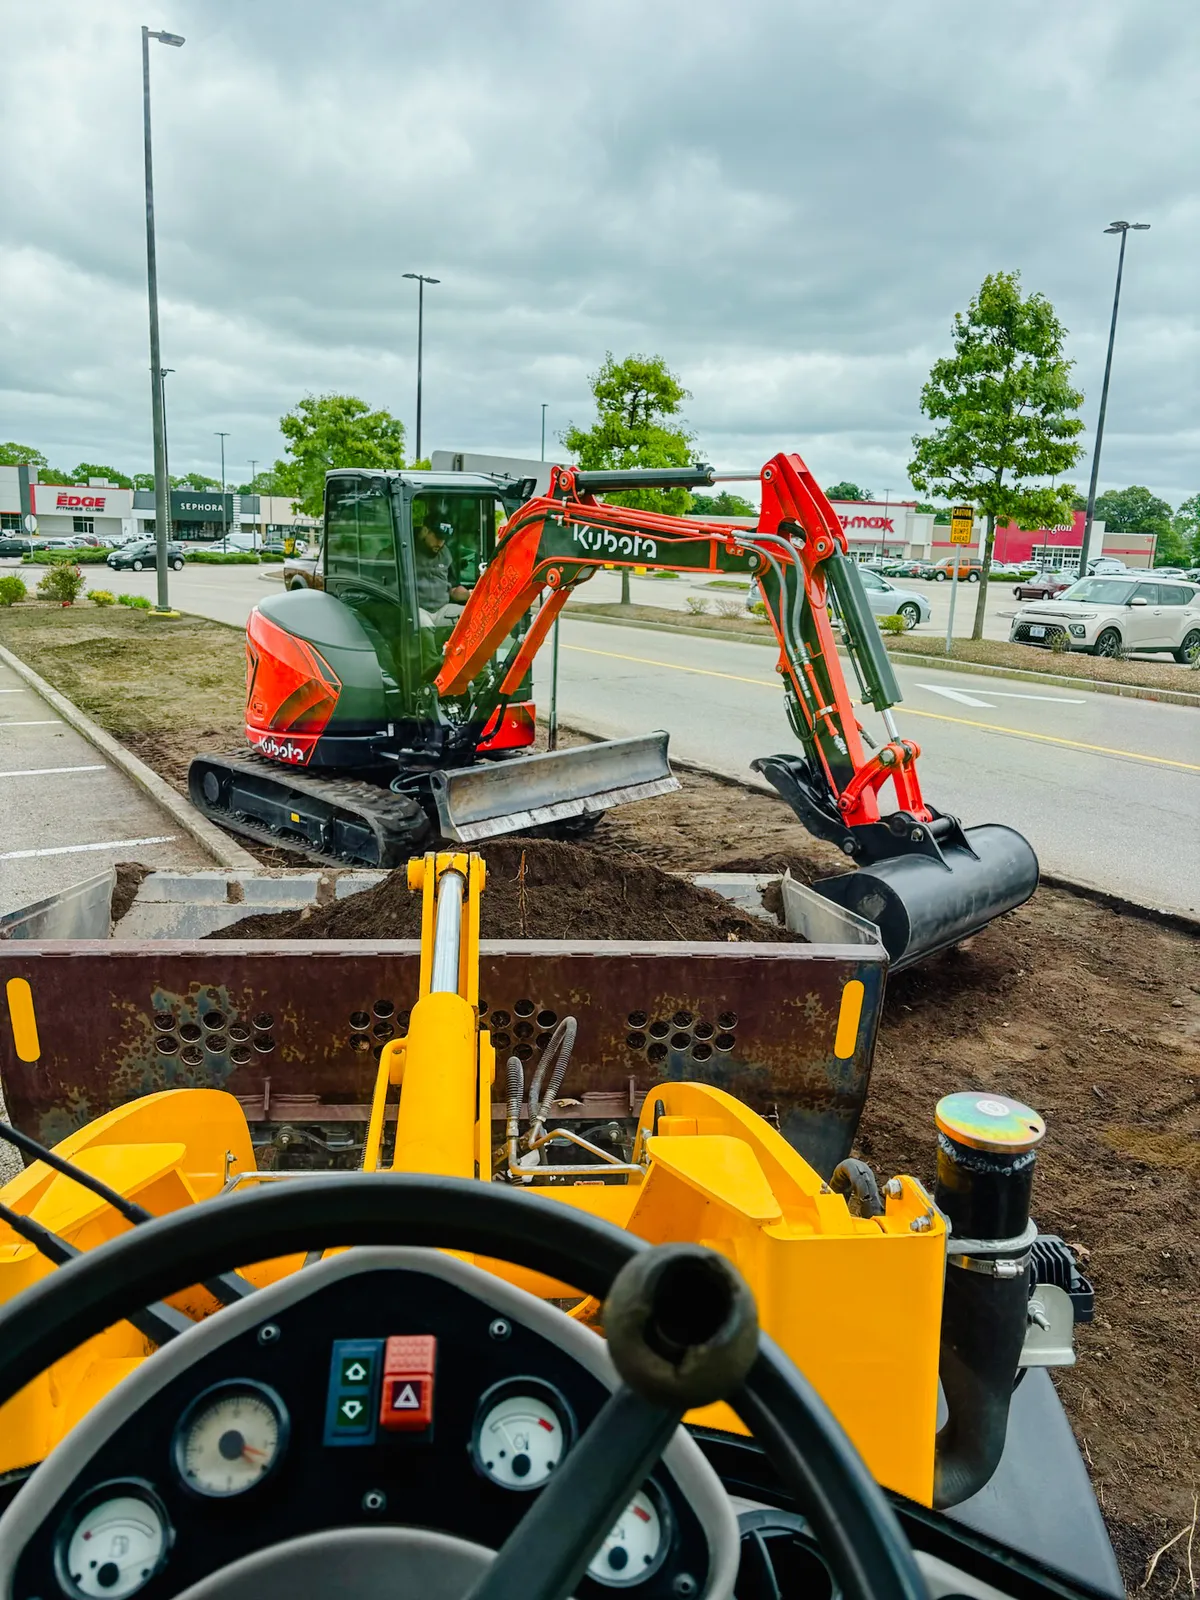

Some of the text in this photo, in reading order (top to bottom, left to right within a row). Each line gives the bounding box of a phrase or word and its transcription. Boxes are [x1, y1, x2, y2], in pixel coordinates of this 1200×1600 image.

[56, 495, 106, 508] EDGE
[180, 502, 223, 512] SEPHORA
[954, 520, 970, 528] SPEED
[953, 527, 969, 535] BUMPS
[573, 523, 657, 558] Kubota
[258, 735, 304, 760] Kubota
